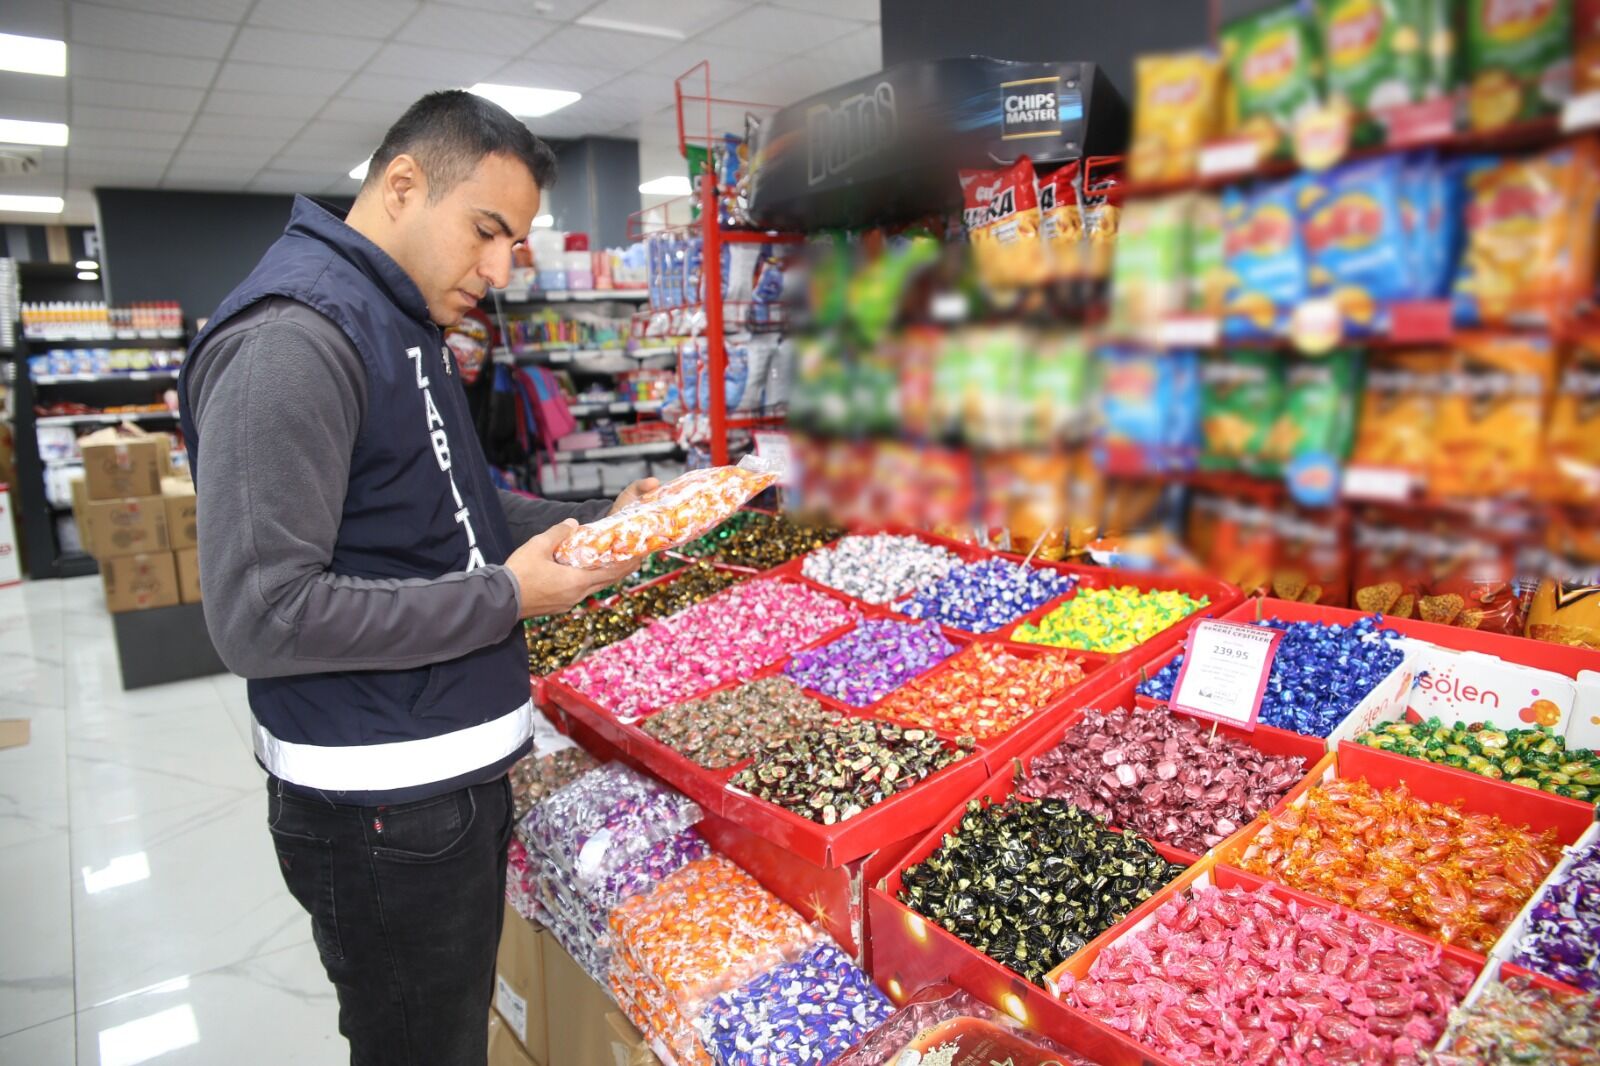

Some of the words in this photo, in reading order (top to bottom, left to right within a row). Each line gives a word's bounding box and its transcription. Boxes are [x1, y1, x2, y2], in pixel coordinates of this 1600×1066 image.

[1005, 93, 1056, 112] CHIPS
[1006, 109, 1057, 125] MASTER
[405, 346, 487, 573] ZABITA
[1213, 645, 1249, 661] 239,95
